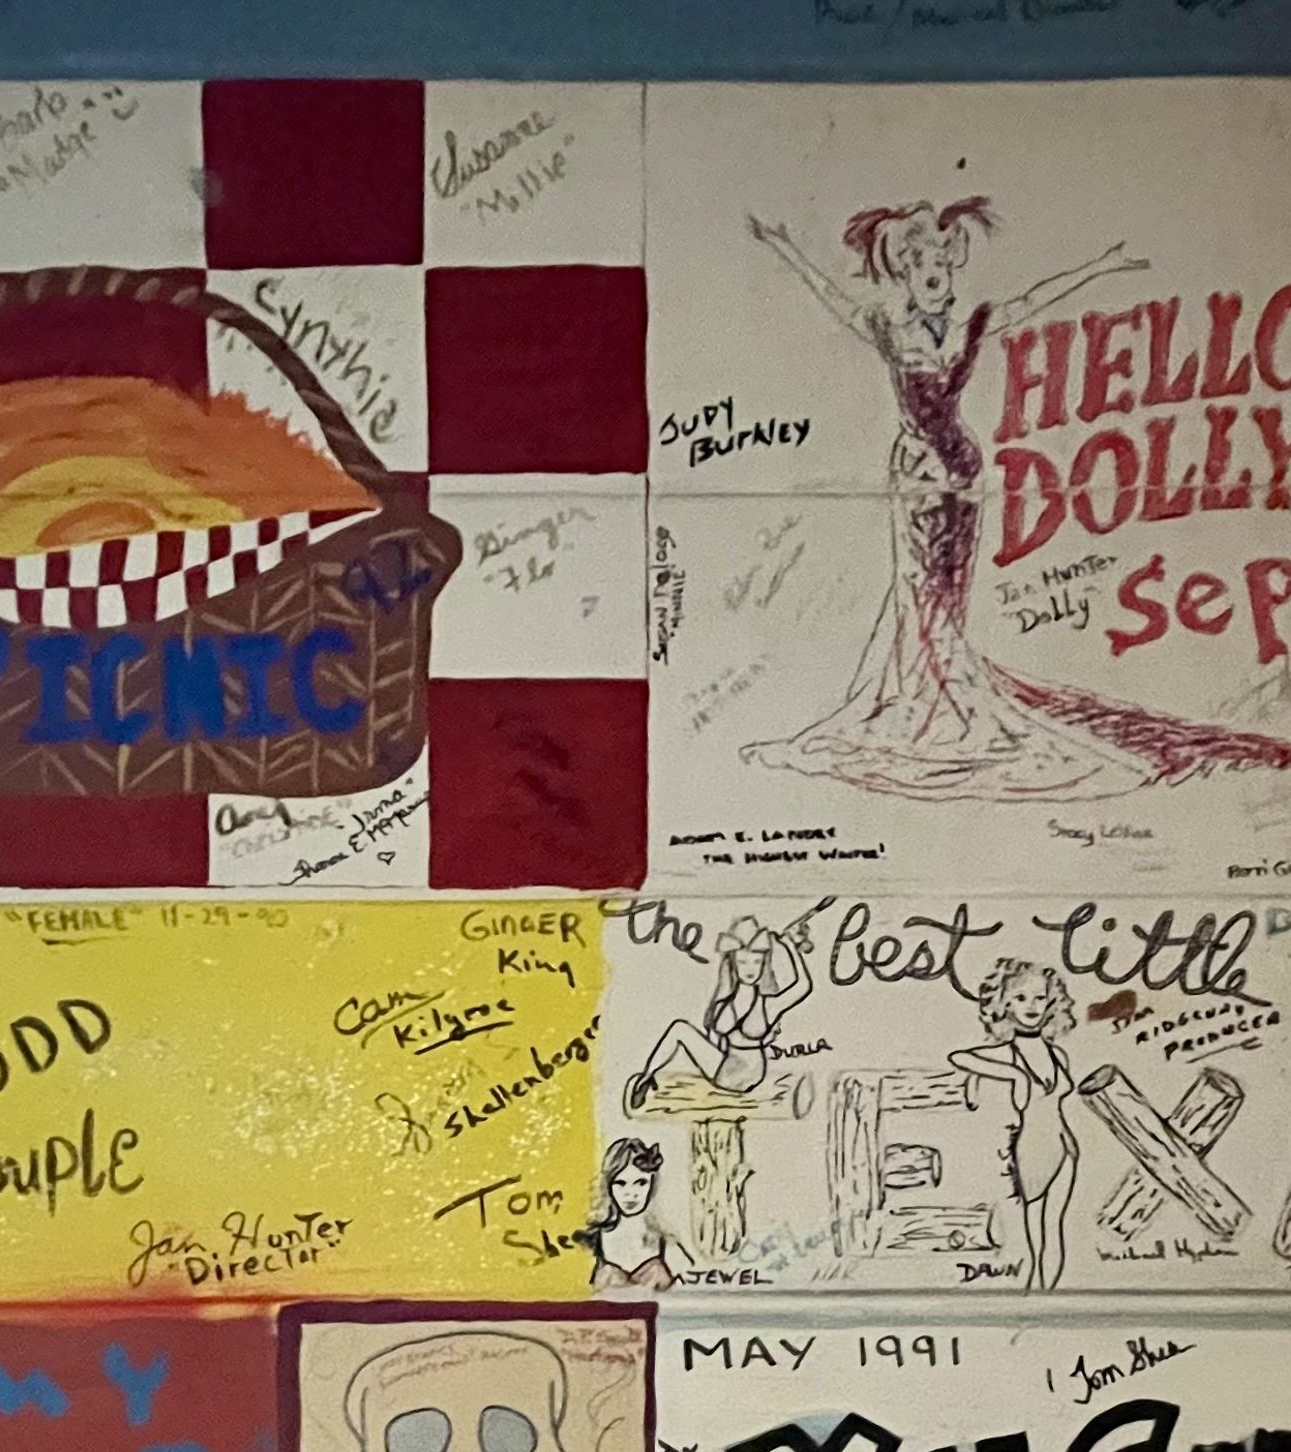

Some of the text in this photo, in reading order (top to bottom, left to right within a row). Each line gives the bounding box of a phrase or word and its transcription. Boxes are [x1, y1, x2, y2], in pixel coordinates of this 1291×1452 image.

[497, 948, 576, 989] King
[828, 901, 1005, 1003] best
[1032, 901, 1273, 1007] little
[432, 1173, 565, 1230] Tom
[683, 1335, 818, 1373] MAY
[858, 1334, 964, 1368] 1991
